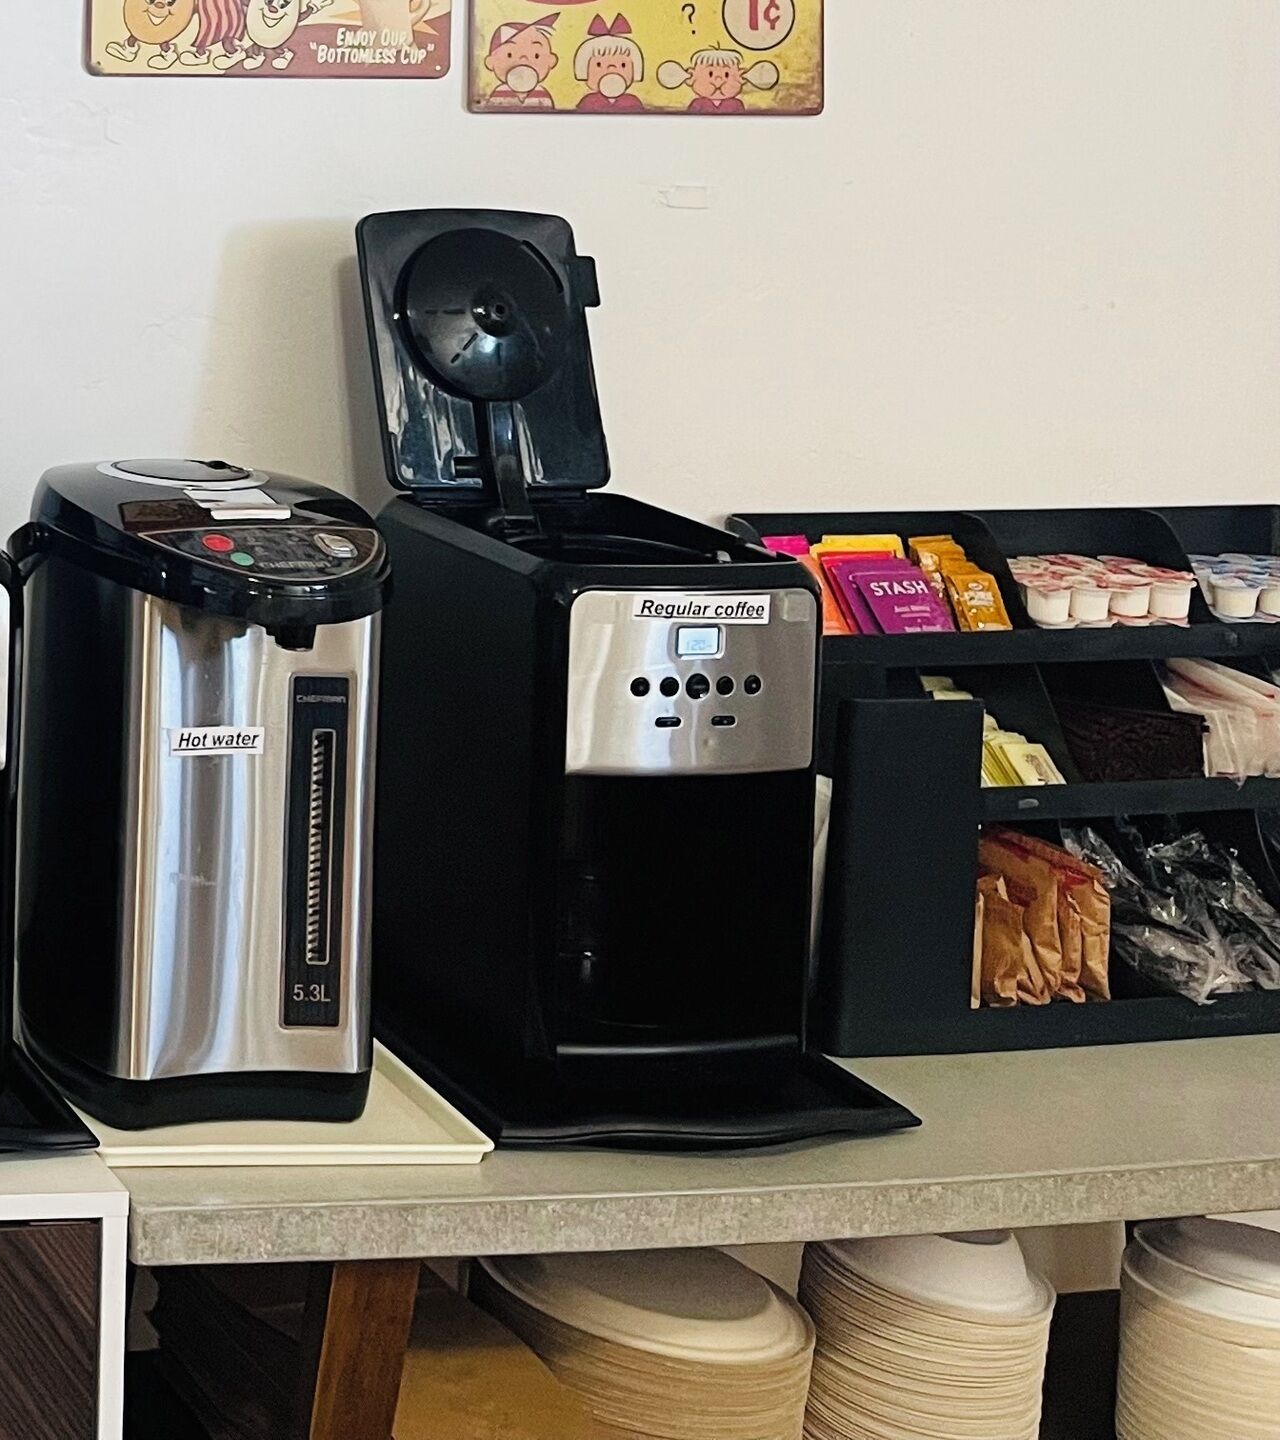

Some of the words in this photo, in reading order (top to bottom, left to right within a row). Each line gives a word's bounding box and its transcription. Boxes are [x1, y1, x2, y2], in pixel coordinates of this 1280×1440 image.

[336, 28, 374, 46] ENJOY
[870, 581, 929, 596] STASH
[641, 600, 710, 618] Regular
[714, 602, 764, 617] coffee
[178, 732, 208, 748] Hot
[212, 732, 260, 746] water
[293, 984, 331, 1002] 5.3L
